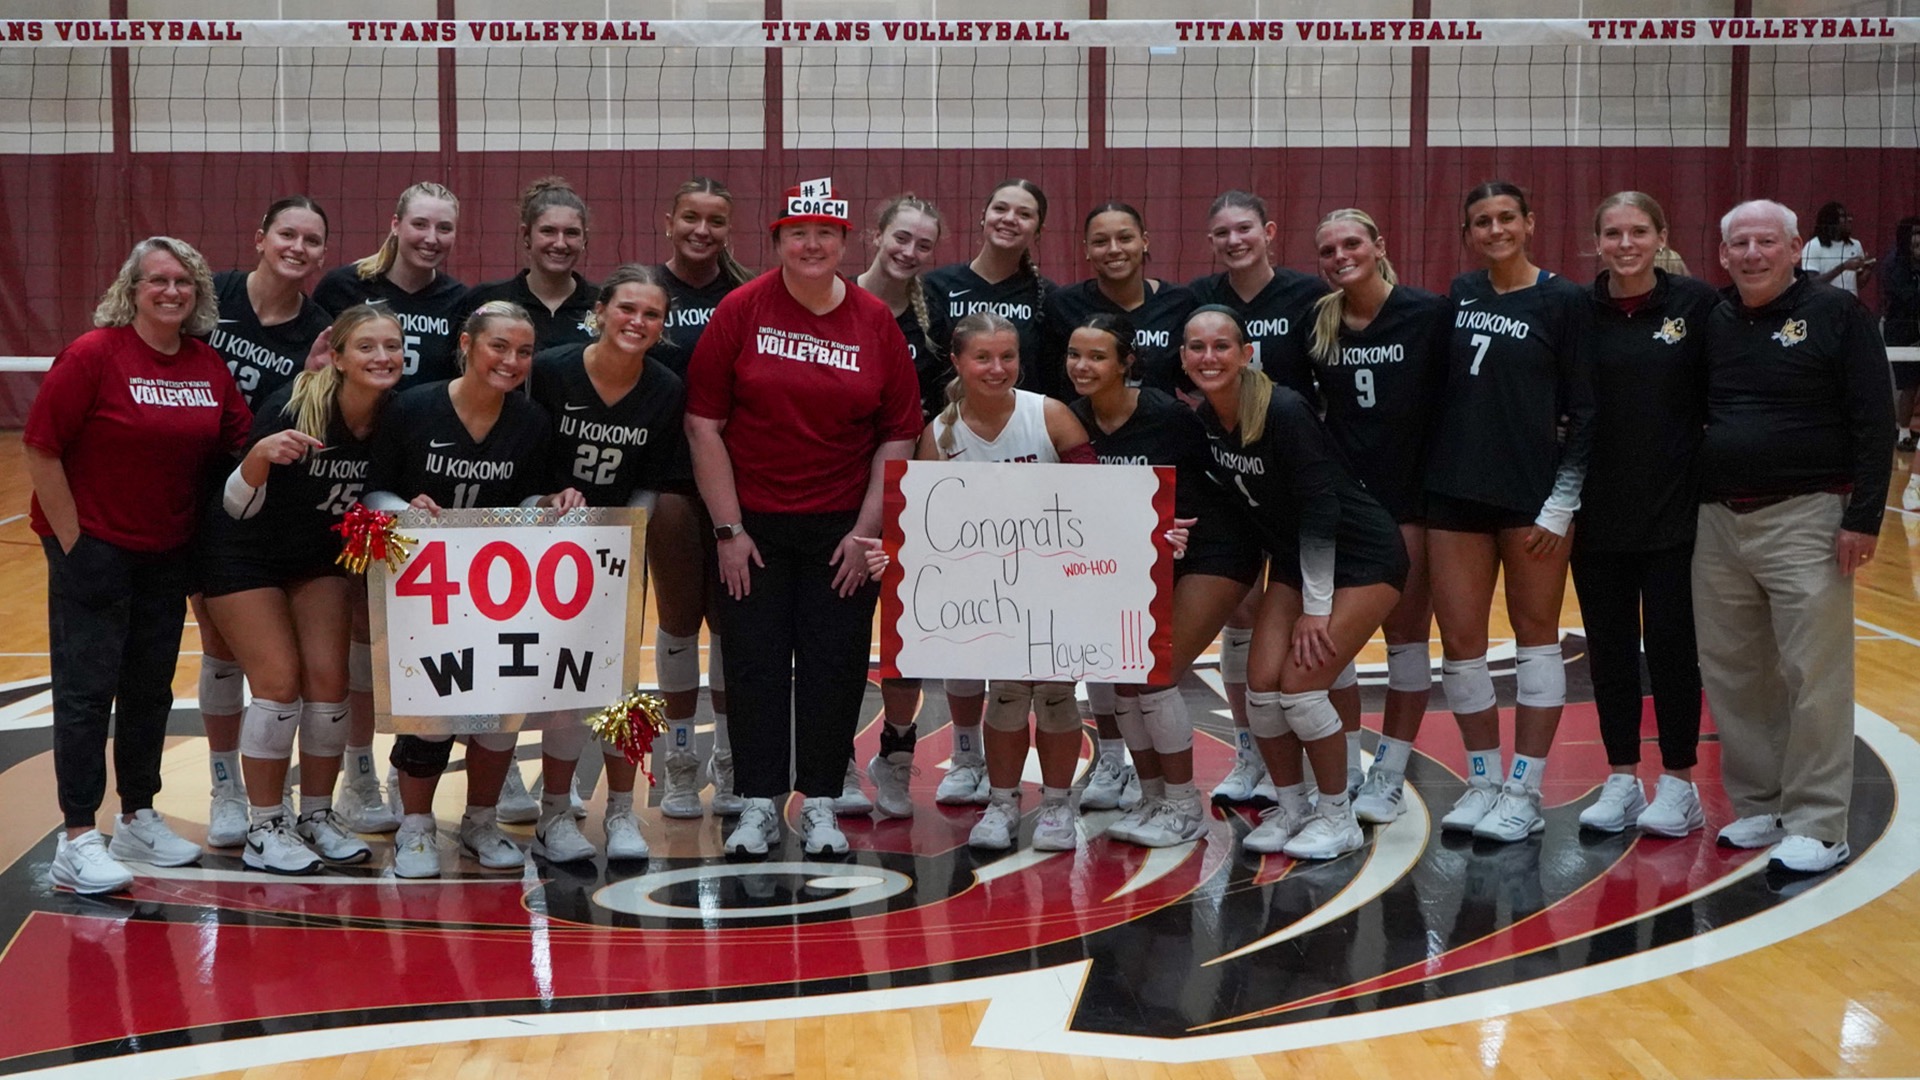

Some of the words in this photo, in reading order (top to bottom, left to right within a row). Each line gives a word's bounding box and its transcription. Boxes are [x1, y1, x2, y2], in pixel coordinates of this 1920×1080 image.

[0, 21, 43, 41] NS
[54, 21, 242, 41] VOLLEYBALL
[347, 21, 456, 41] TITANS
[468, 20, 656, 40] VOLLEYBALL
[761, 21, 870, 41] TITANS
[882, 20, 1070, 40] VOLLEYBALL
[1174, 21, 1283, 41] TITANS
[1296, 20, 1483, 40] VOLLEYBALL
[1588, 20, 1696, 40] TITANS
[1710, 18, 1895, 38] VOLLEYBALL
[791, 199, 845, 217] COACH
[950, 301, 964, 318] IU
[967, 301, 1032, 320] KOKOMO
[394, 313, 449, 336] OKOMO
[1455, 310, 1469, 328] IU
[1466, 311, 1530, 340] KOKOMO
[208, 328, 227, 349] IU
[225, 334, 295, 376] KOKOMO
[757, 334, 861, 373] VOLLEYBALL
[1342, 343, 1404, 365] KOKOMO
[1470, 333, 1492, 376] 7
[129, 385, 219, 407] VOLLEYBALL
[1354, 368, 1376, 408] 9
[560, 415, 577, 436] IU
[578, 420, 648, 446] KOKOMO
[308, 459, 328, 477] IU
[425, 453, 444, 474] IU
[445, 457, 514, 480] KOKOMO
[572, 444, 623, 485] 22
[315, 483, 364, 516] 15
[452, 482, 480, 509] 11
[924, 477, 1085, 586] Congrats
[1062, 559, 1118, 578] WOO-HOO
[913, 564, 1021, 632] Coach
[419, 632, 594, 698] WIN
